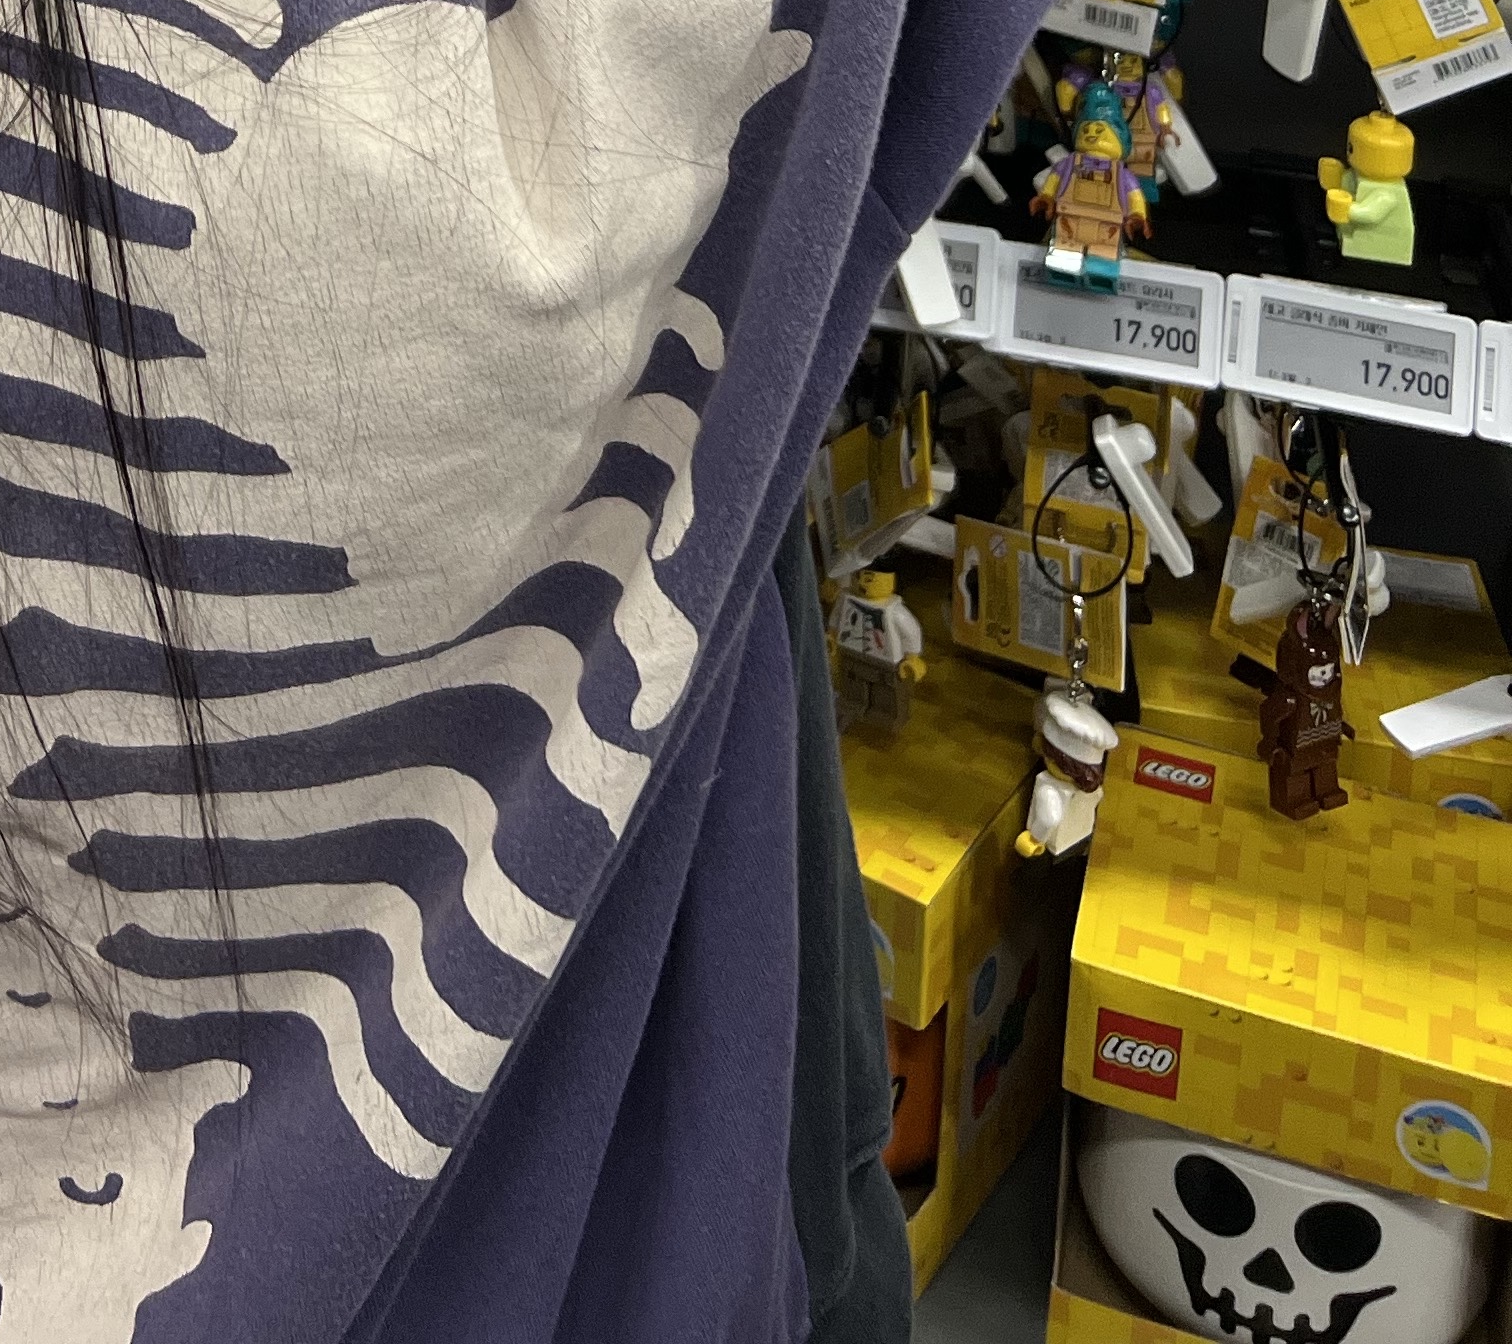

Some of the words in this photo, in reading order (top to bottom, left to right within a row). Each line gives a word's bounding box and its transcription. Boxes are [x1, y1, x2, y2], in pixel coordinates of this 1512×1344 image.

[1113, 318, 1196, 354] 17,900
[1361, 359, 1449, 399] 17,900
[1141, 759, 1210, 789] LEGO
[1099, 1033, 1176, 1075] LEGO
